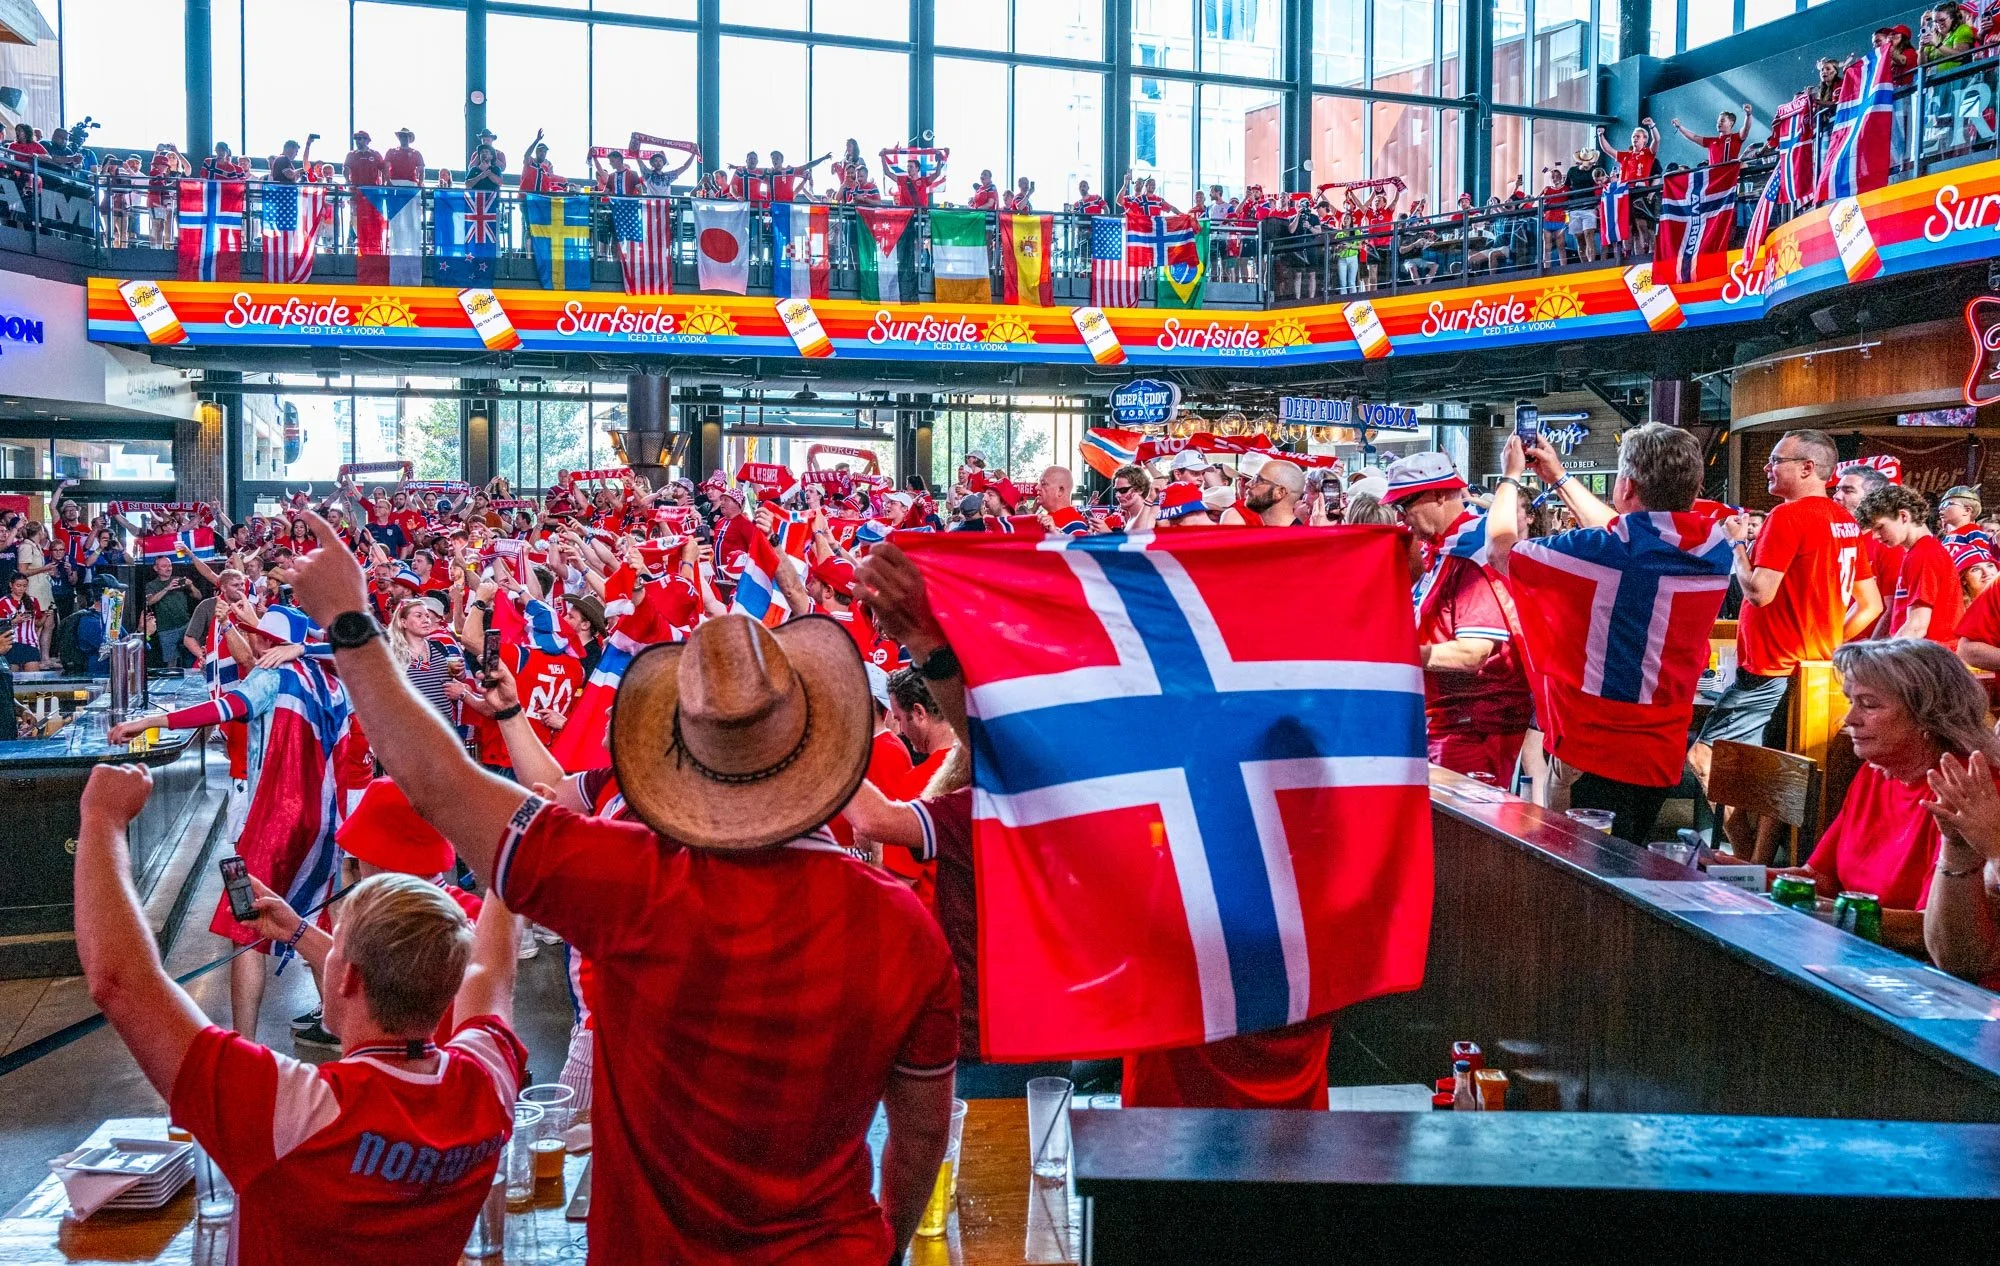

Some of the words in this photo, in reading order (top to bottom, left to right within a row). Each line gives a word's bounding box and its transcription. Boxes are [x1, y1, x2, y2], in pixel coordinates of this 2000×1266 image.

[1686, 193, 1700, 255] AVERØY
[1632, 275, 1653, 295] Surfs
[129, 287, 160, 308] Surfside
[467, 294, 496, 315] Surfside
[224, 292, 349, 329] Surfside
[556, 300, 674, 336] Surfside
[784, 304, 811, 324] Surfside
[1421, 295, 1525, 337] Surfside
[0, 313, 43, 343] ON
[325, 327, 343, 335] TEA
[353, 327, 385, 335] VODKA
[867, 309, 977, 345] Surfside
[1157, 317, 1259, 351] Surfside
[1482, 327, 1500, 336] ICED
[1503, 325, 1520, 334] TEA
[1528, 321, 1557, 332] VODKA
[627, 333, 648, 342] ICED
[651, 334, 668, 342] TEA
[677, 335, 708, 343] VODKA
[955, 343, 971, 351] TEA
[980, 343, 1008, 351] VODKA
[1262, 348, 1287, 356] VODKA
[1116, 393, 1137, 407] DEEP
[1144, 391, 1168, 405] EDDY
[1120, 408, 1164, 417] VODKA
[1285, 397, 1317, 420] DEEP
[1320, 400, 1352, 423] EDDY
[1363, 403, 1419, 428] VODKA
[821, 445, 860, 457] NORGE
[1561, 461, 1578, 469] COLD
[1578, 460, 1595, 468] BEER
[805, 472, 842, 482] NORGE
[128, 501, 194, 510] NORGE
